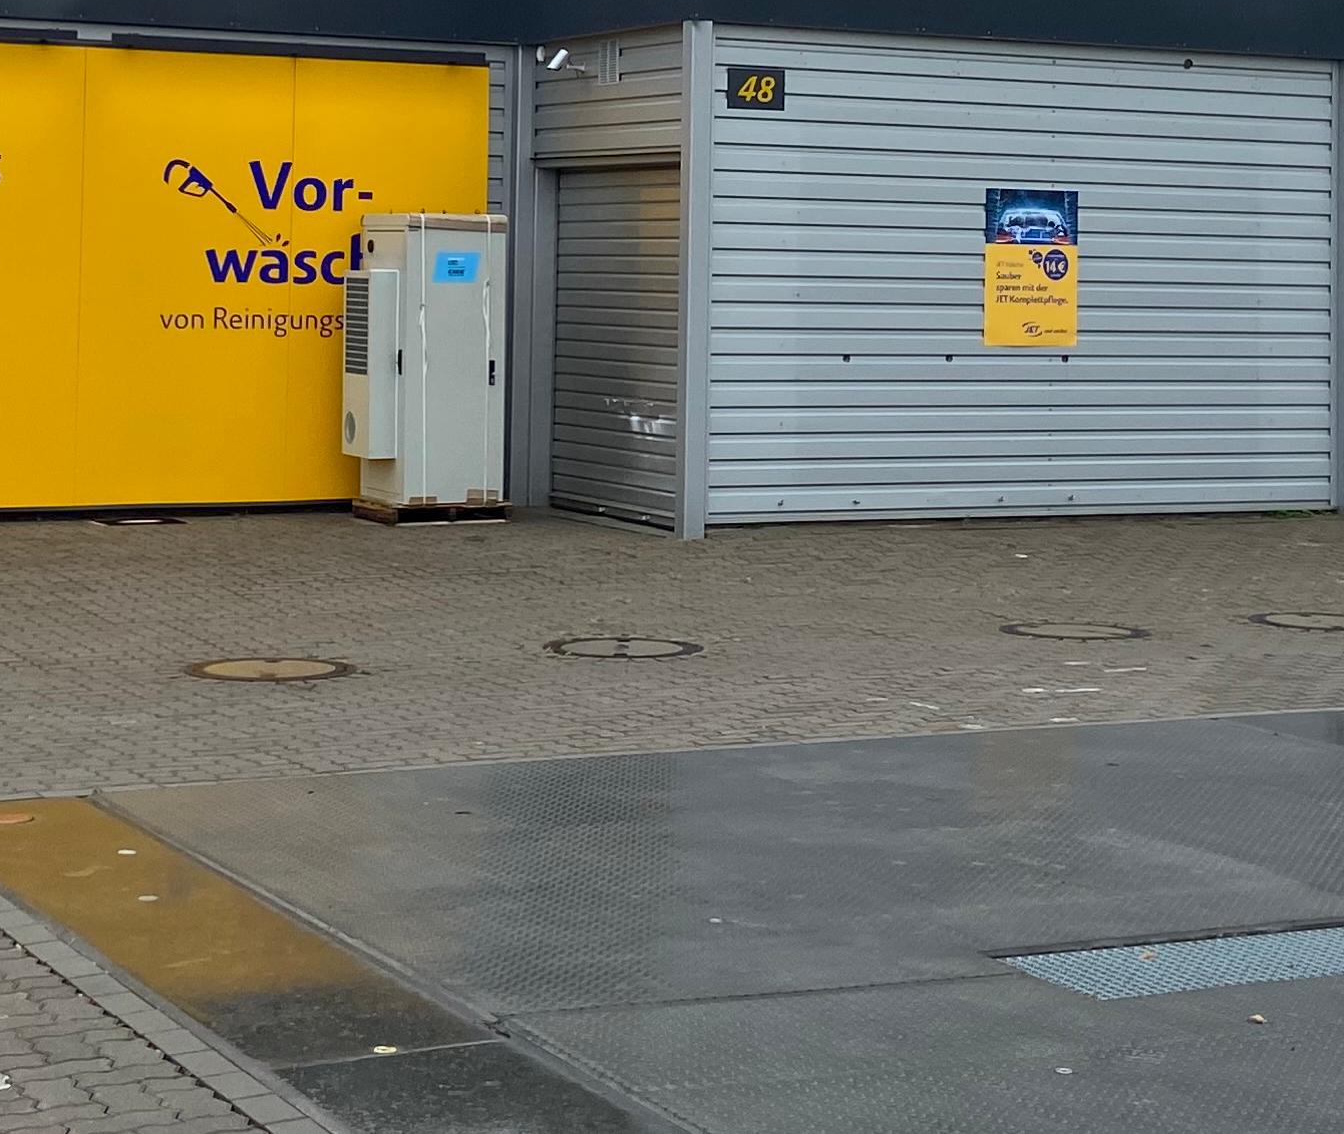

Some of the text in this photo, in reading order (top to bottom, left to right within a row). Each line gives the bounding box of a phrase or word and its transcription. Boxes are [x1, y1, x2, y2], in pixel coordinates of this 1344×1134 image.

[737, 74, 776, 103] 48
[248, 160, 374, 212] Vor-
[996, 271, 1022, 280] Sauber
[996, 283, 1048, 294] sparen mit der
[996, 294, 1008, 303] JET
[159, 313, 205, 331] von
